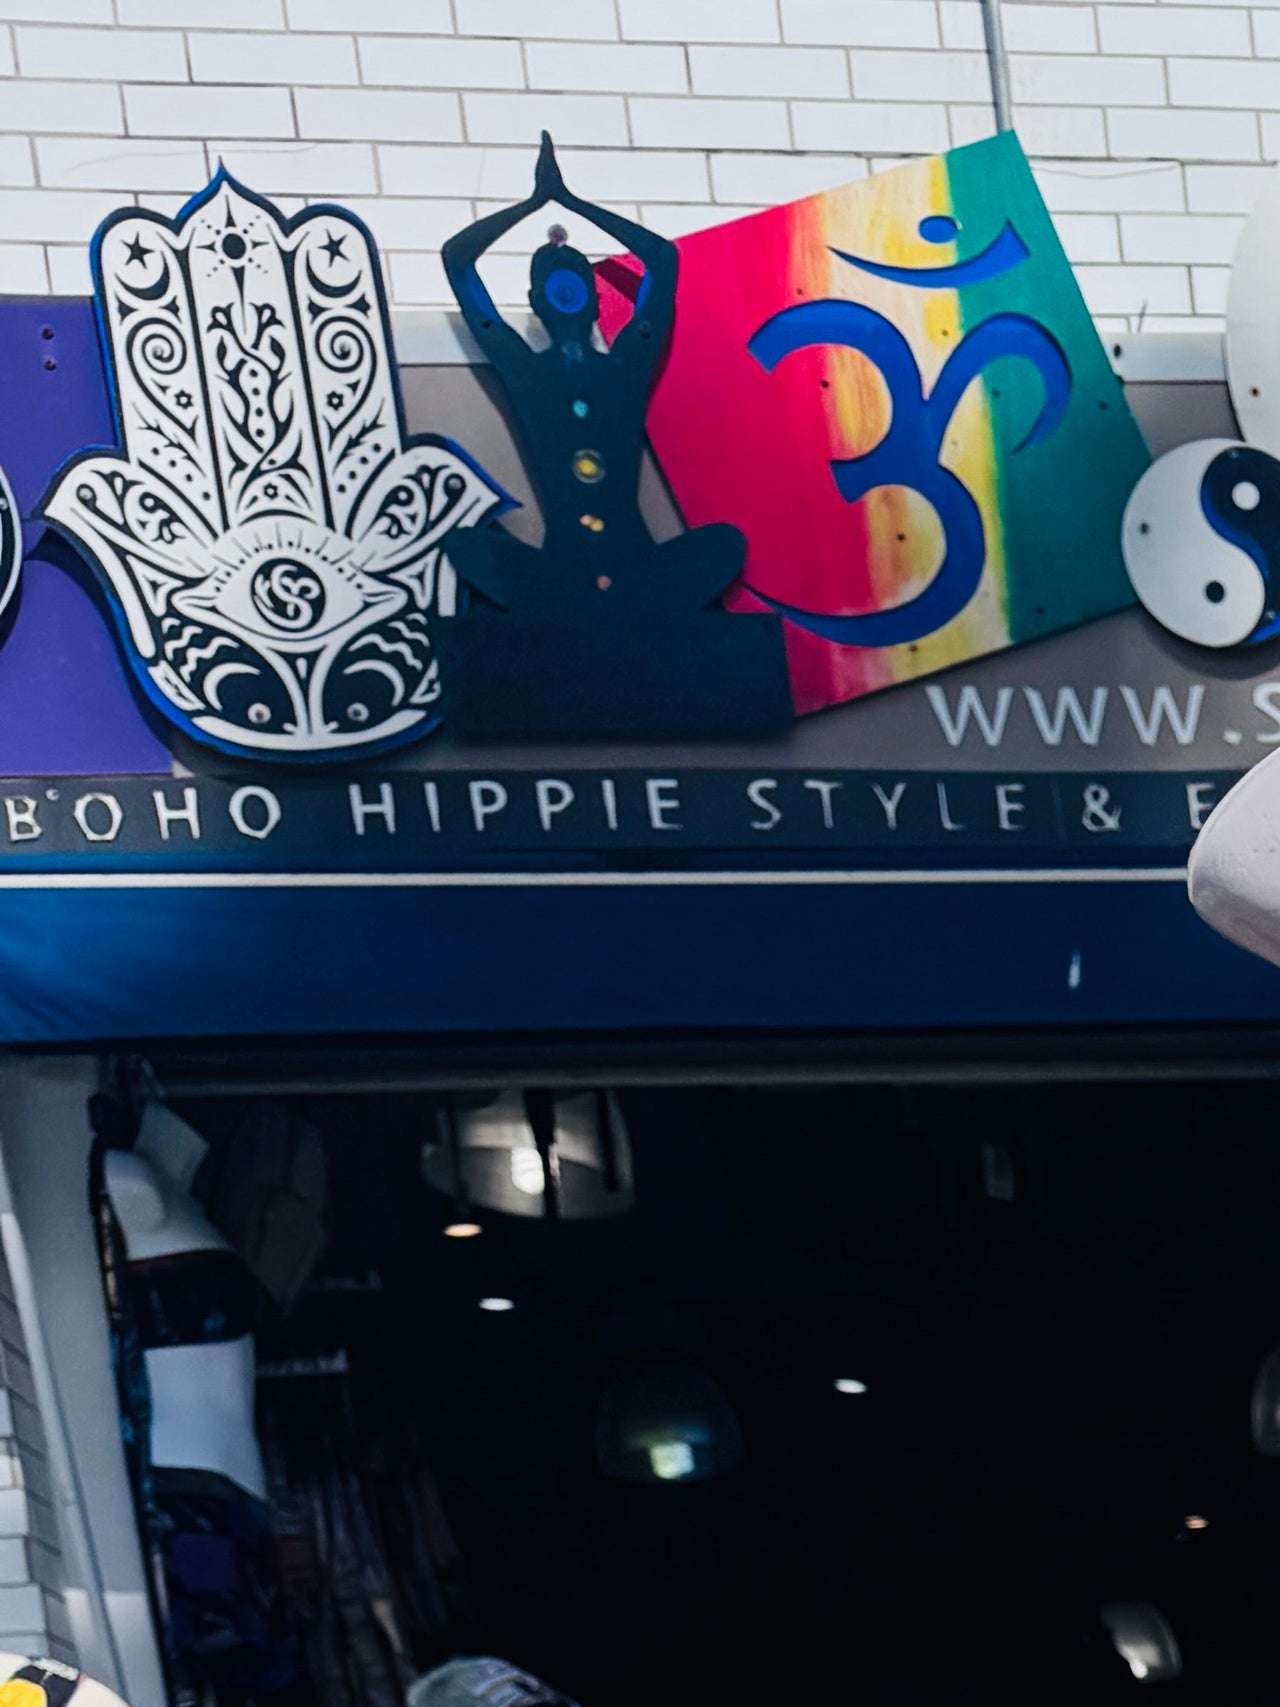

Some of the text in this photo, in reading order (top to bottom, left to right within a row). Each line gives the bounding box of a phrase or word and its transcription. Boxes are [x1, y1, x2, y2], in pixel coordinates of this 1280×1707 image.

[4, 784, 282, 842] BOHO
[348, 778, 683, 835] HIPPIE
[747, 777, 1025, 833] STYLE
[1080, 782, 1122, 832] &
